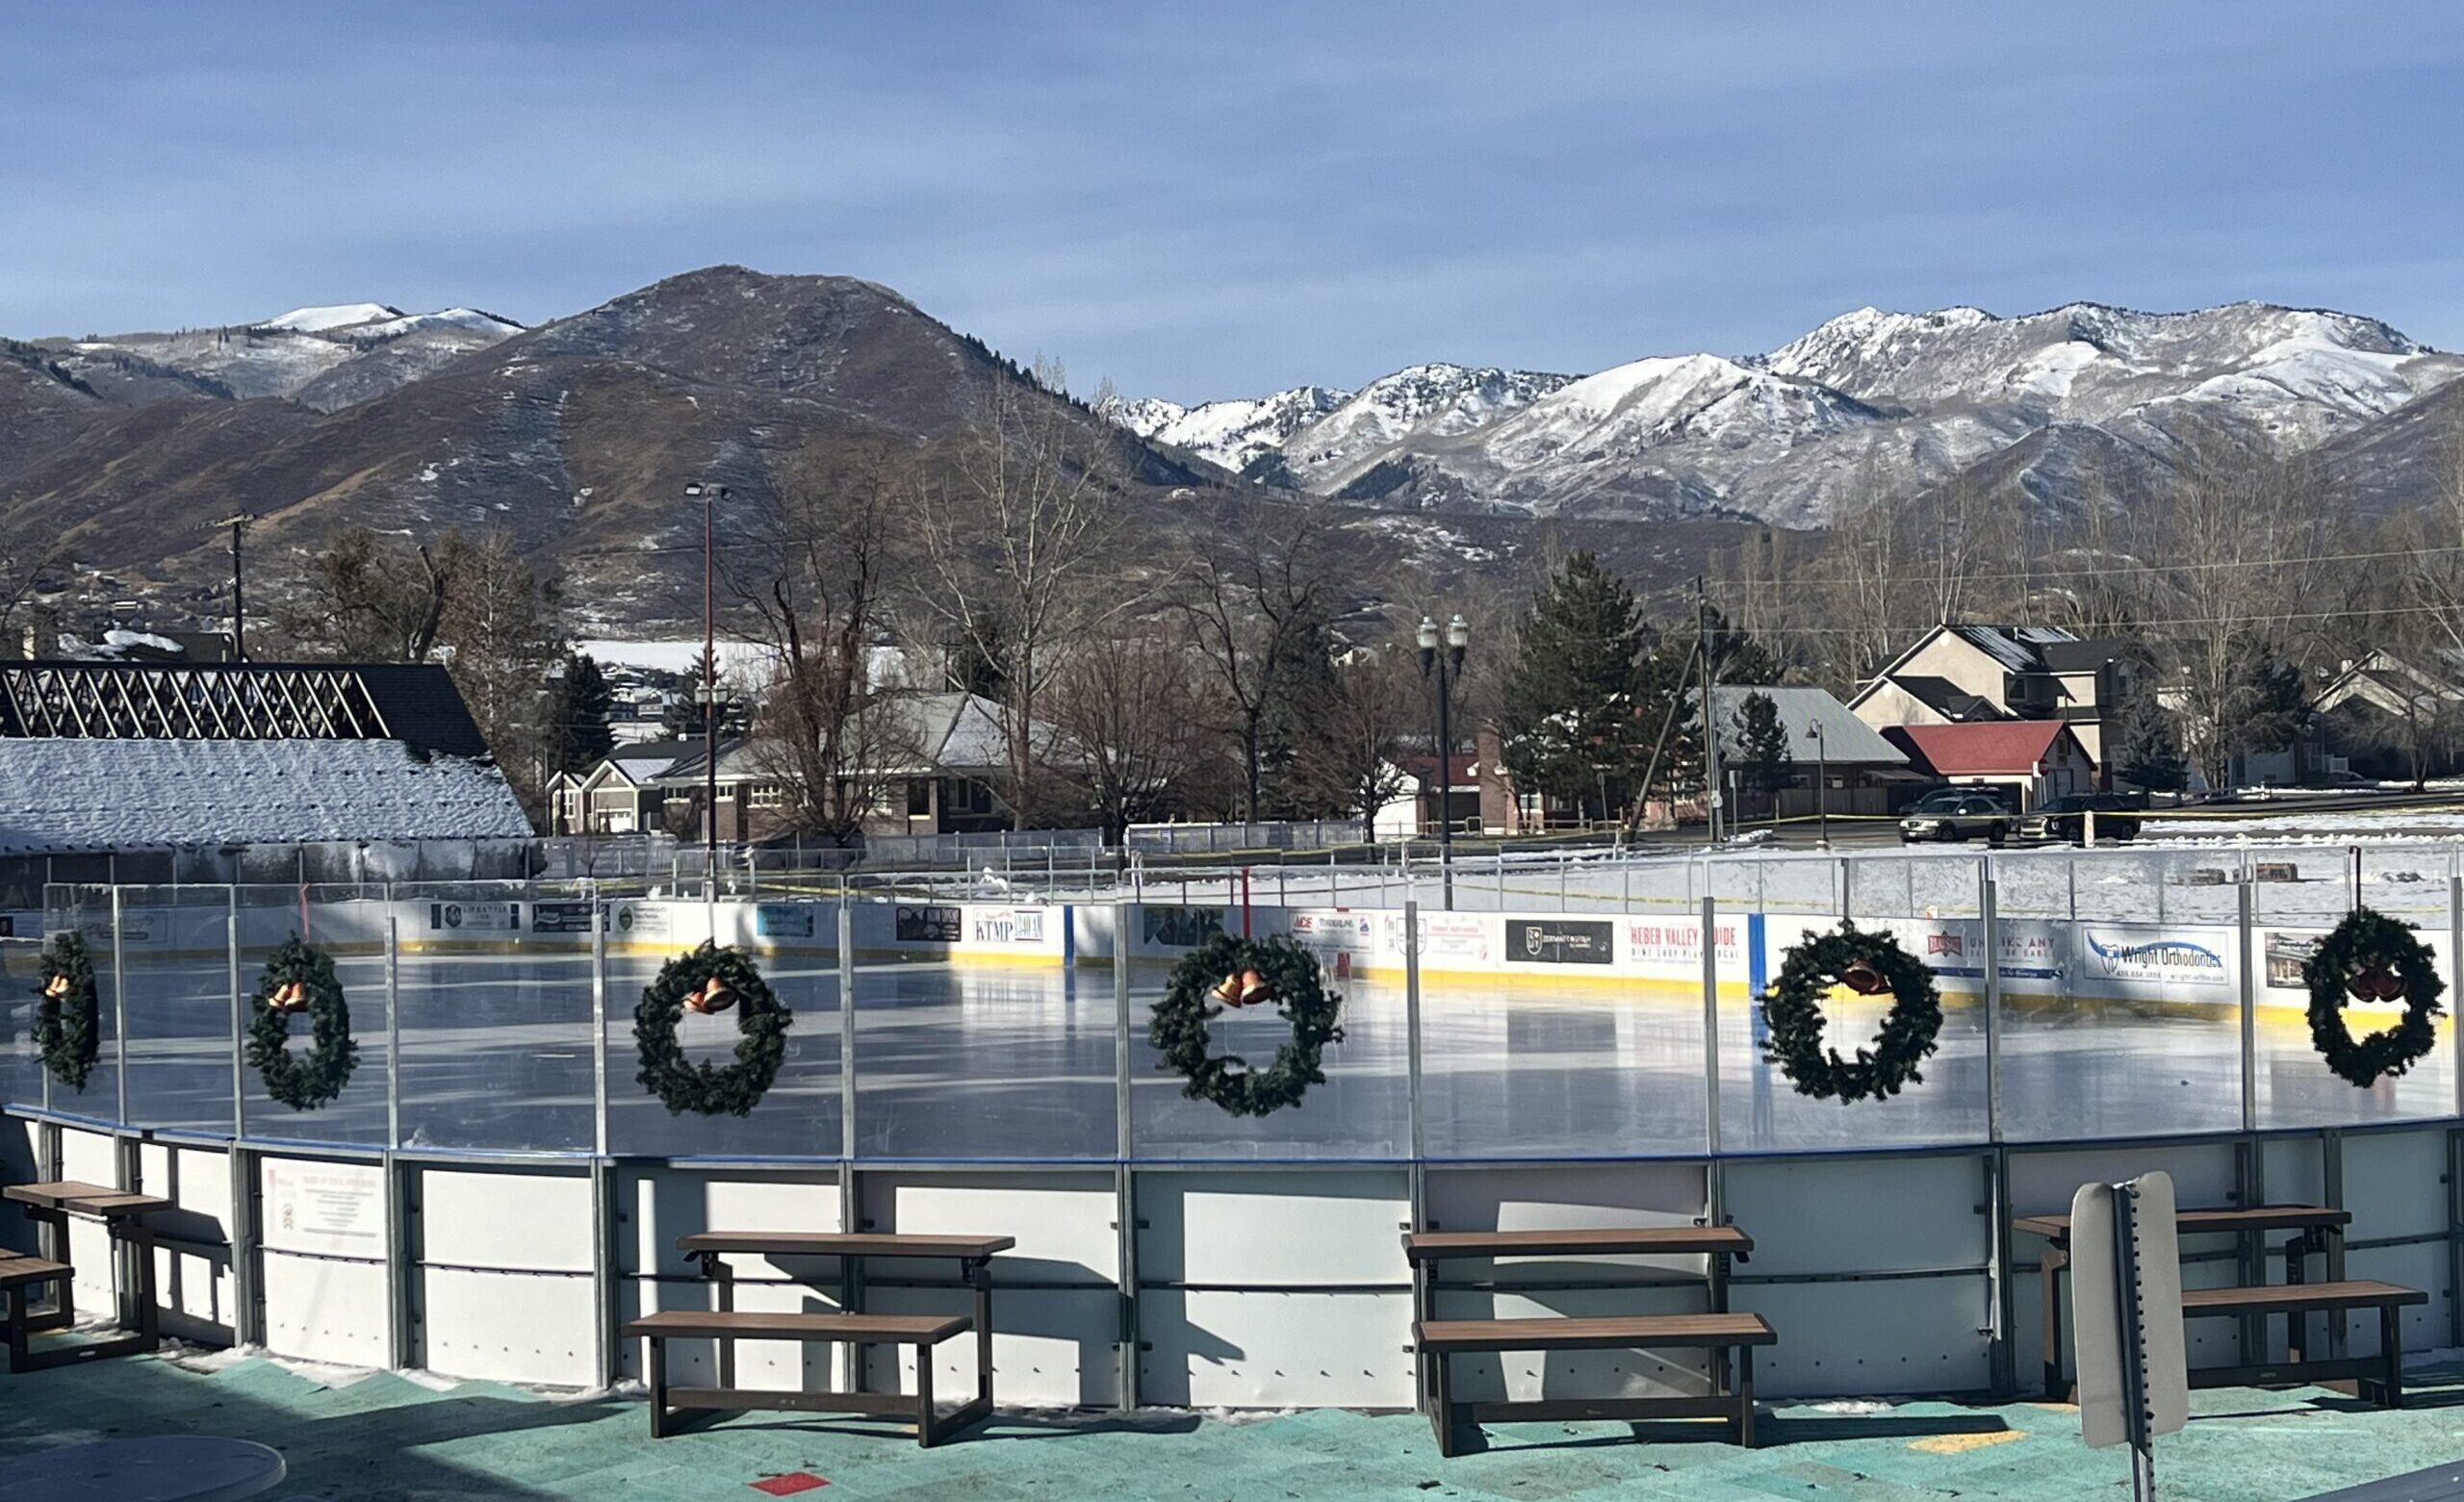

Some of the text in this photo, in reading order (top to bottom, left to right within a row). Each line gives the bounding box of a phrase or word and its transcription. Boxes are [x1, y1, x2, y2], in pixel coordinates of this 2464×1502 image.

[976, 921, 1013, 941] KTMP
[1630, 927, 1736, 946] HEBER VALLEY UIDE
[2029, 937, 2054, 949] ANY
[2121, 946, 2158, 968] Wright
